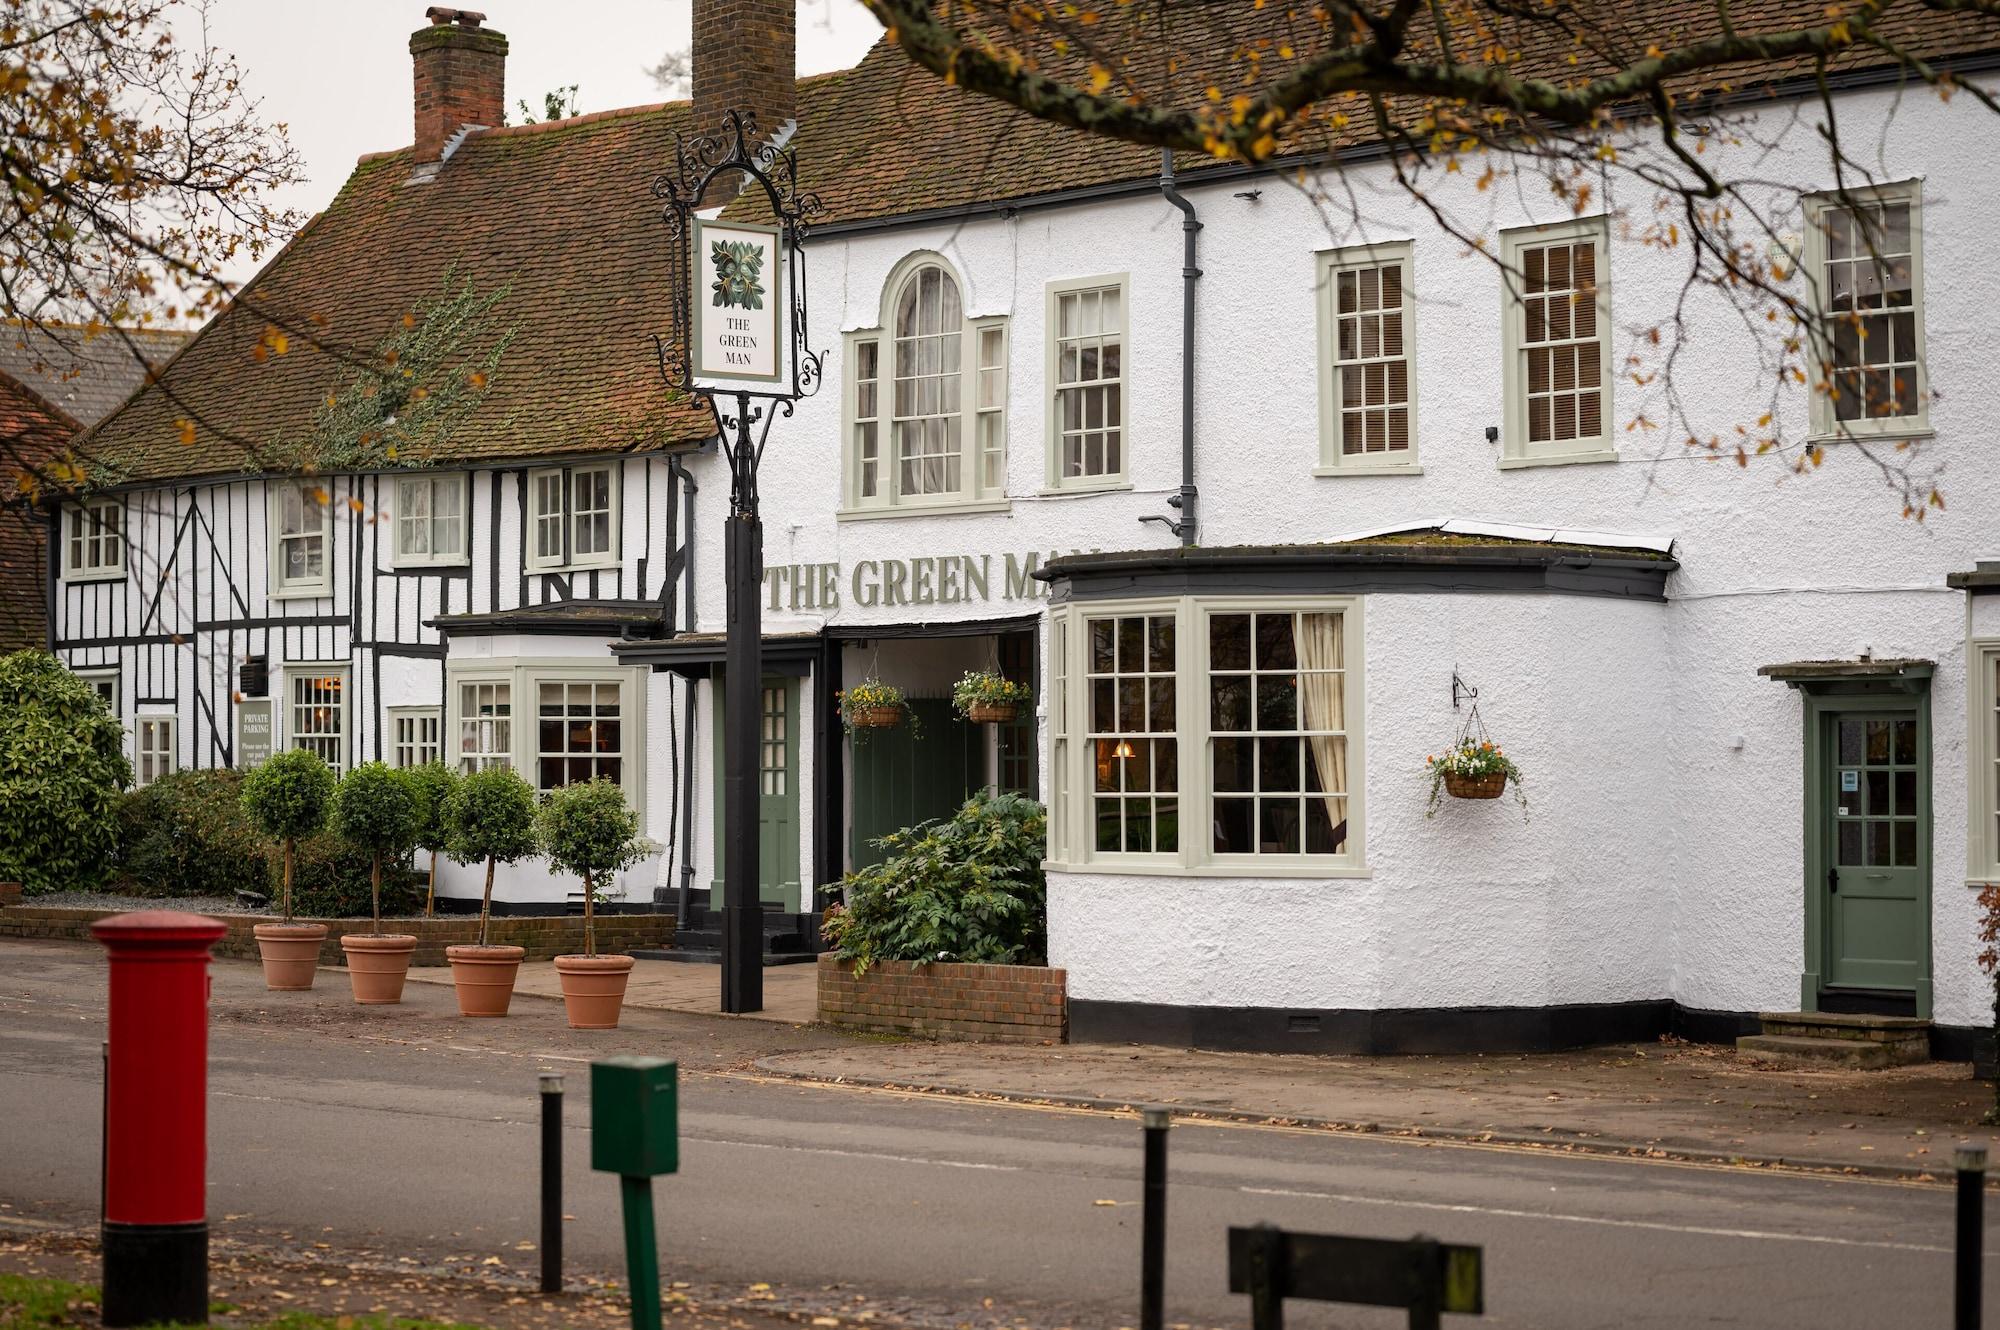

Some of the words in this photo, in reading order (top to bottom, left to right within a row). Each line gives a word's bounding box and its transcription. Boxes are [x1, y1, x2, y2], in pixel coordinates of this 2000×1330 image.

[726, 317, 750, 331] THE
[719, 334, 757, 349] GREEN
[725, 352, 752, 365] MAN
[762, 562, 840, 611] THE
[851, 554, 991, 608] GREEN
[244, 713, 269, 723] PRIVATE
[243, 724, 269, 734] PARKING
